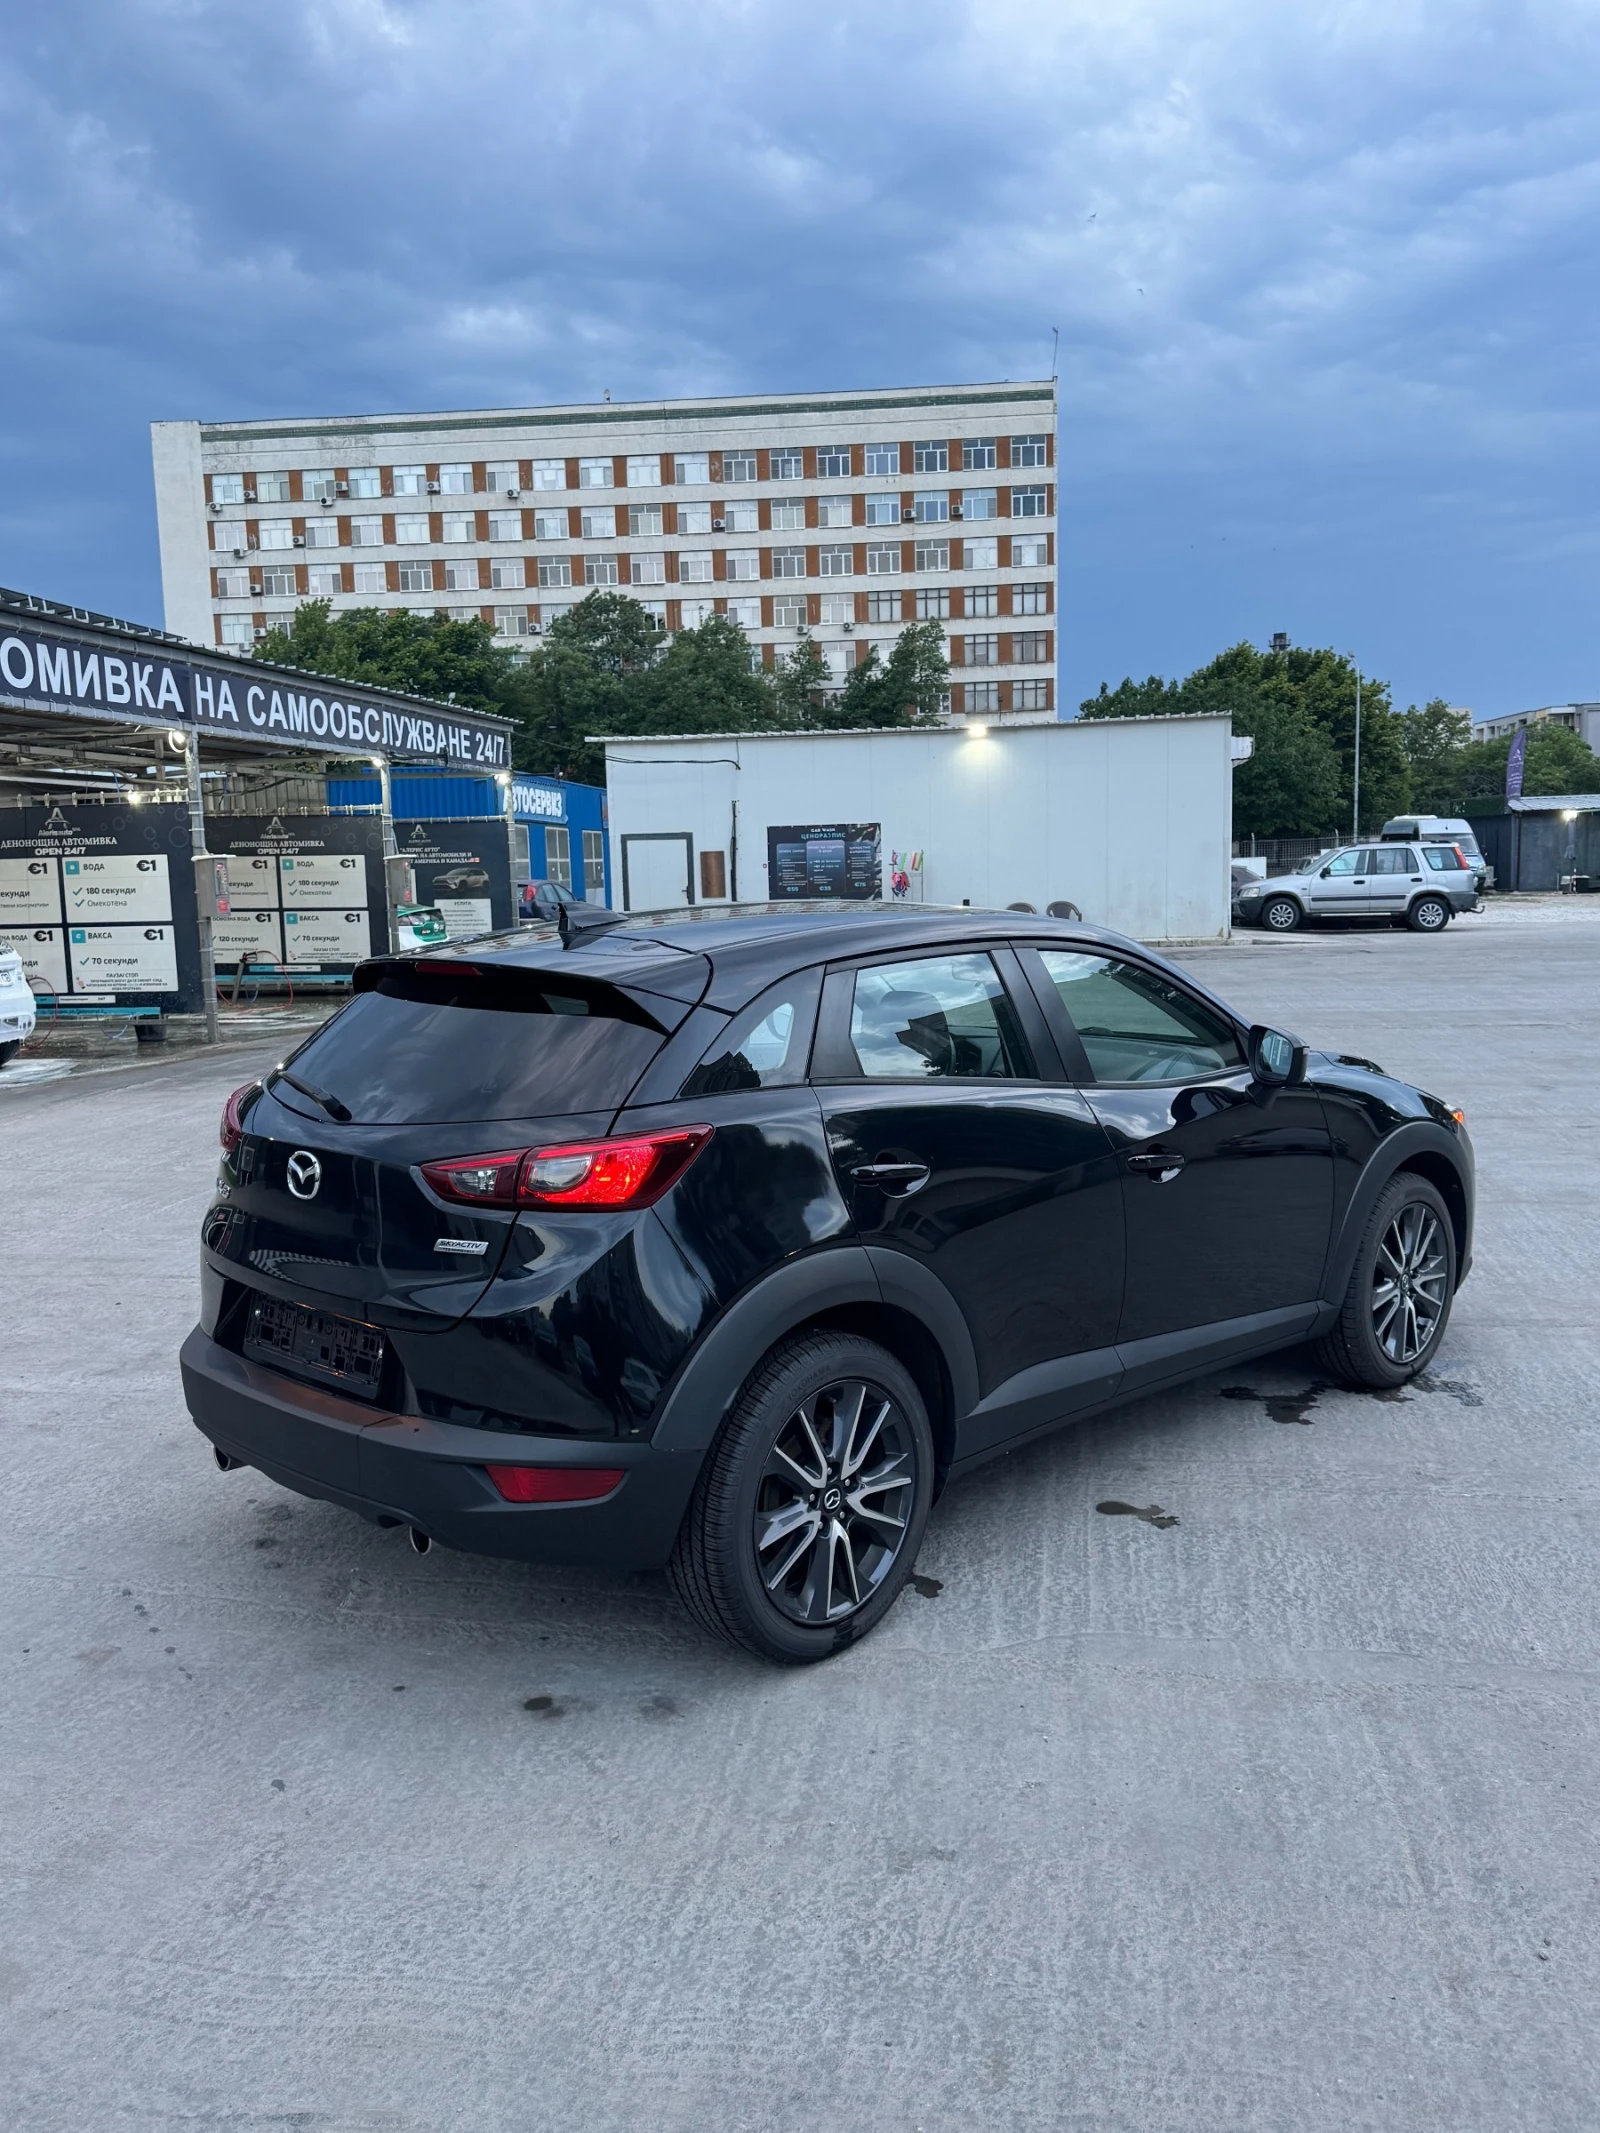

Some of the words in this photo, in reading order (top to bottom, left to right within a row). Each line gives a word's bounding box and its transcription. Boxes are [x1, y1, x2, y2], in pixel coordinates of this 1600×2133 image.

[0, 637, 185, 713] ОМИВКА
[195, 673, 239, 723] НА
[247, 685, 472, 759] САМООБСЛУЖВАНЕ
[475, 732, 505, 764] 24/7
[800, 832, 846, 840] ЦЕНОРАЗПИС
[1, 838, 60, 849] ДЕНОНОЩНА
[62, 836, 118, 846] АВТОМИВКА
[35, 847, 63, 856] OPEN
[64, 846, 87, 855] 24/7
[281, 847, 300, 855] 24/7
[83, 863, 105, 871] ВОДА
[136, 859, 157, 872] €1
[252, 859, 268, 869] €1
[340, 858, 356, 868] €1
[28, 862, 48, 875] €1
[86, 887, 100, 895] 180
[101, 887, 137, 896] секунди
[87, 899, 128, 907] Омекотена
[255, 913, 271, 923] €1
[344, 913, 360, 923] €1
[33, 930, 53, 942] €1
[144, 928, 164, 941] €1
[91, 957, 102, 965] 70
[103, 957, 138, 966] секунди
